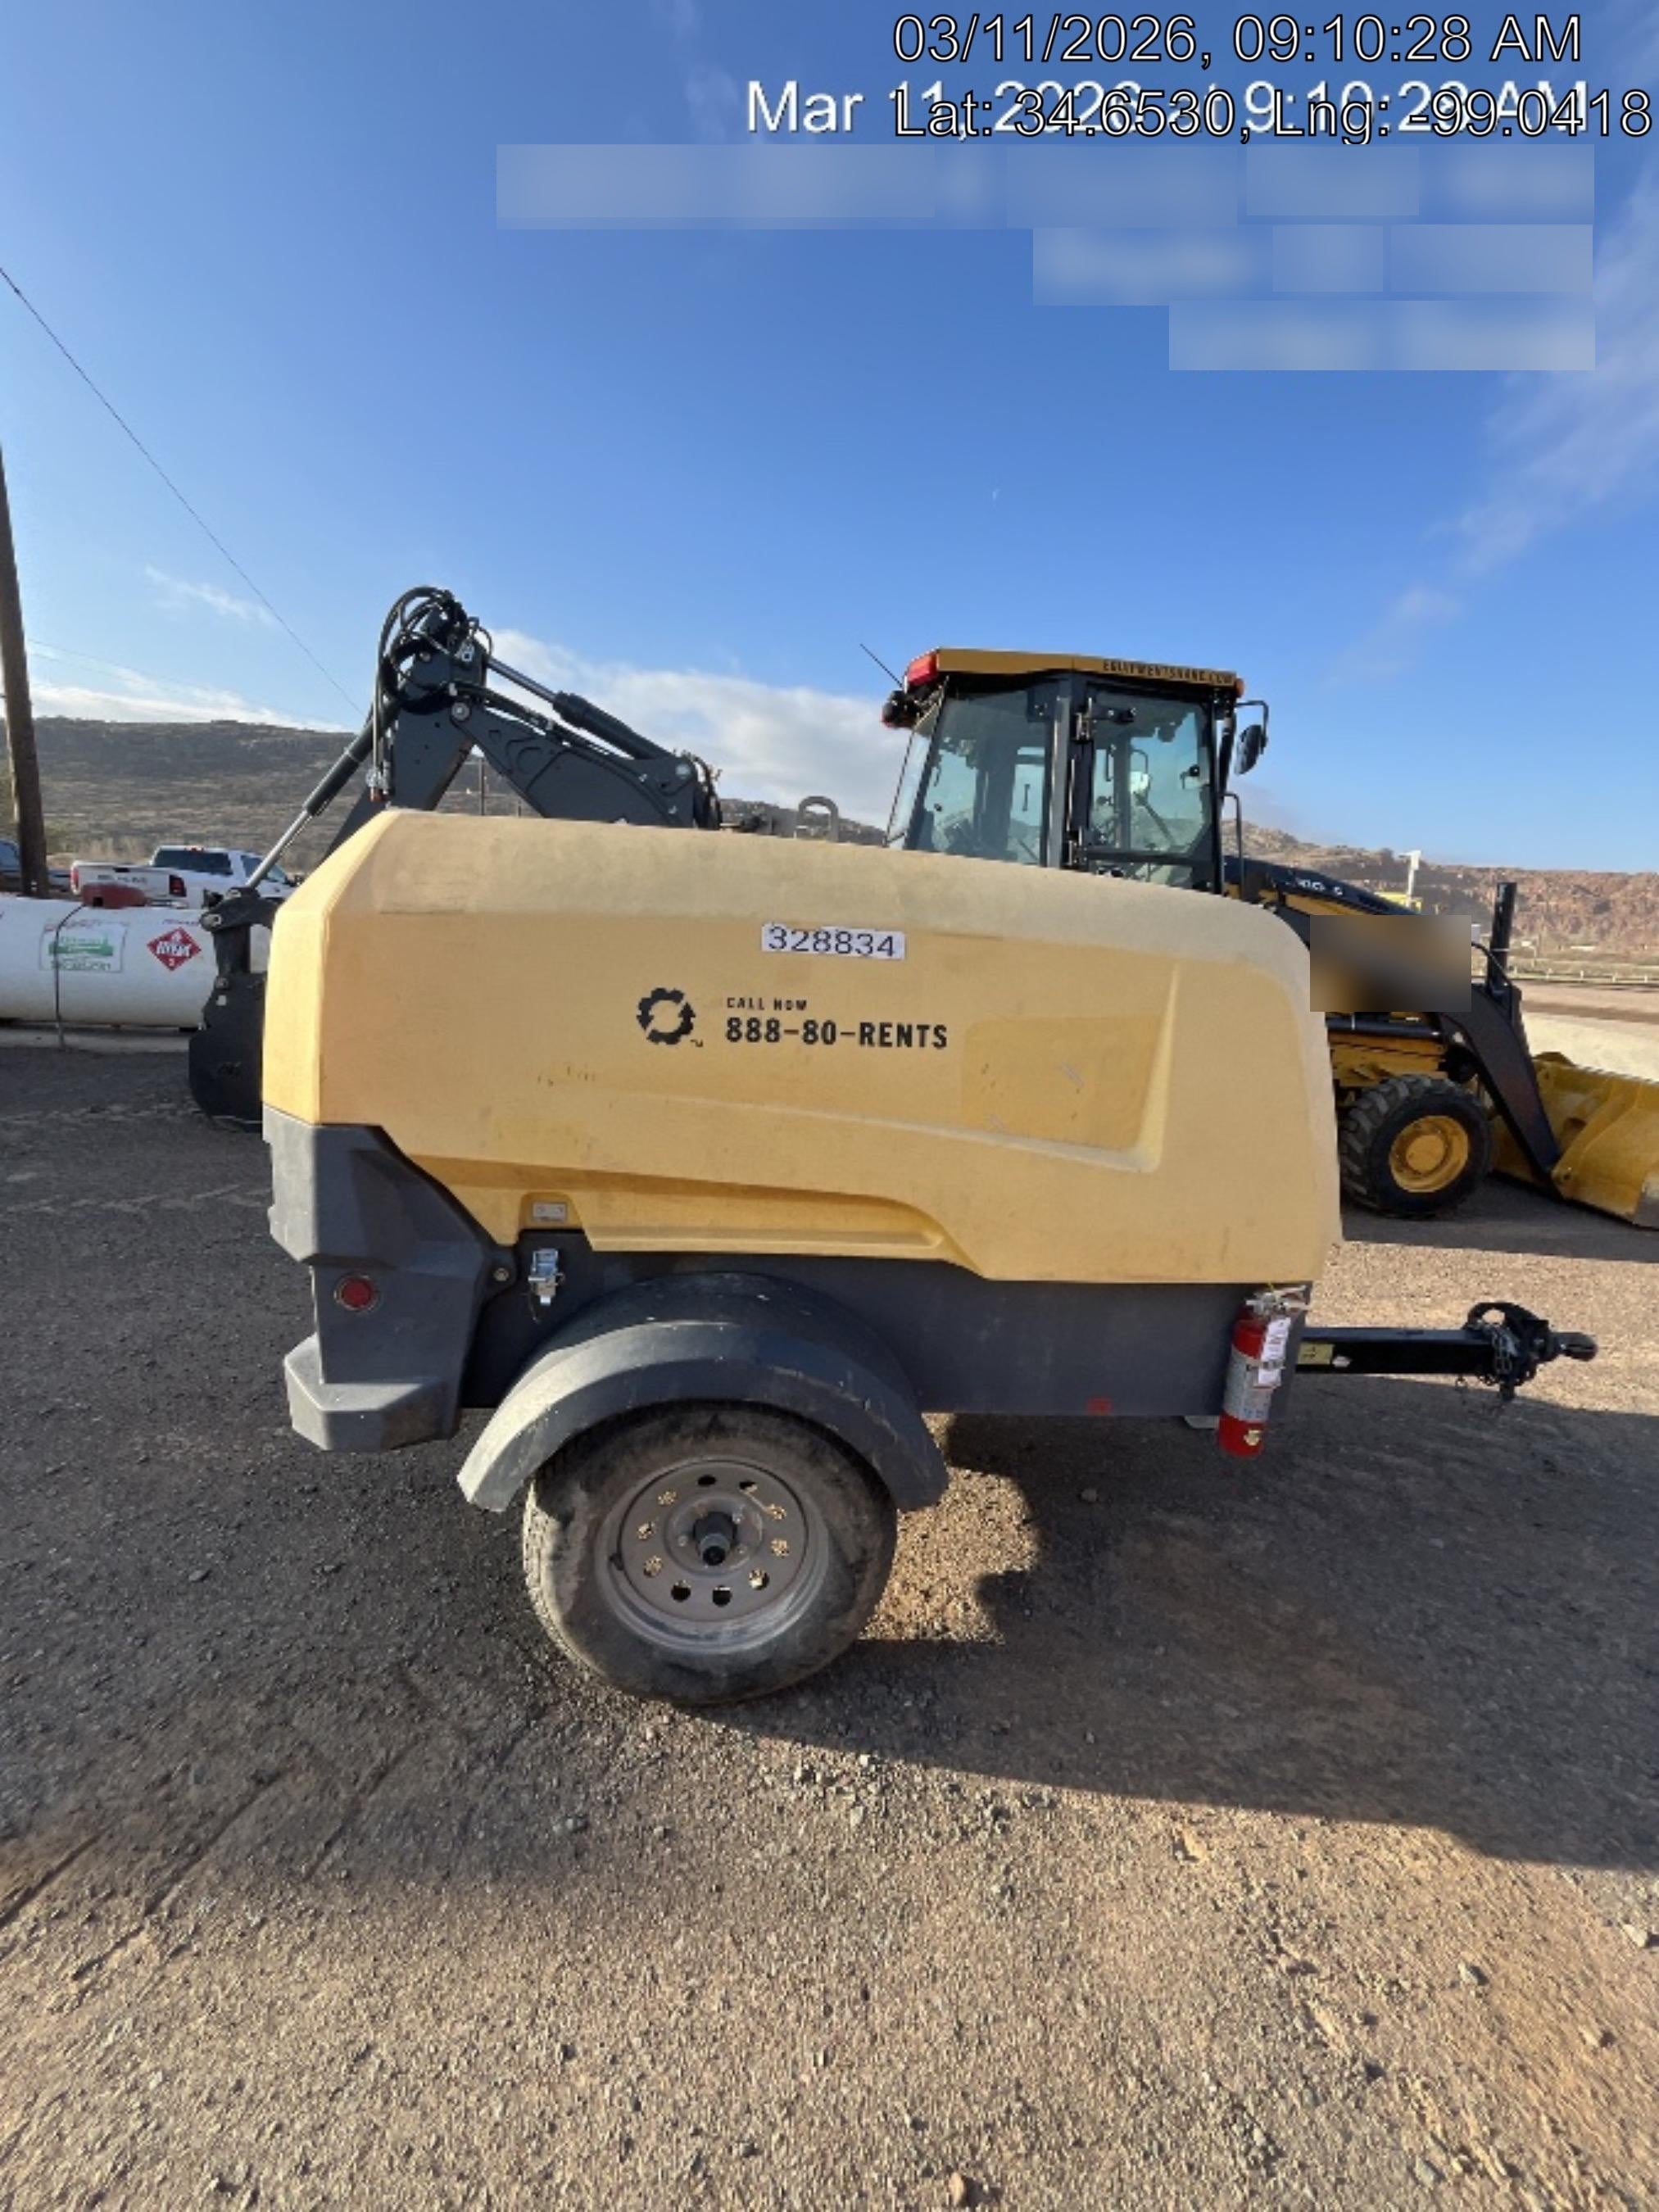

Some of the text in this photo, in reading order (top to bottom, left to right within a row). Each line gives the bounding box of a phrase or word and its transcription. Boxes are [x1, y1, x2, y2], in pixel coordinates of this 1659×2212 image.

[768, 925, 895, 957] 328834
[727, 997, 807, 1011] CALL NOW
[726, 1017, 948, 1049] 888-80-RENTS
